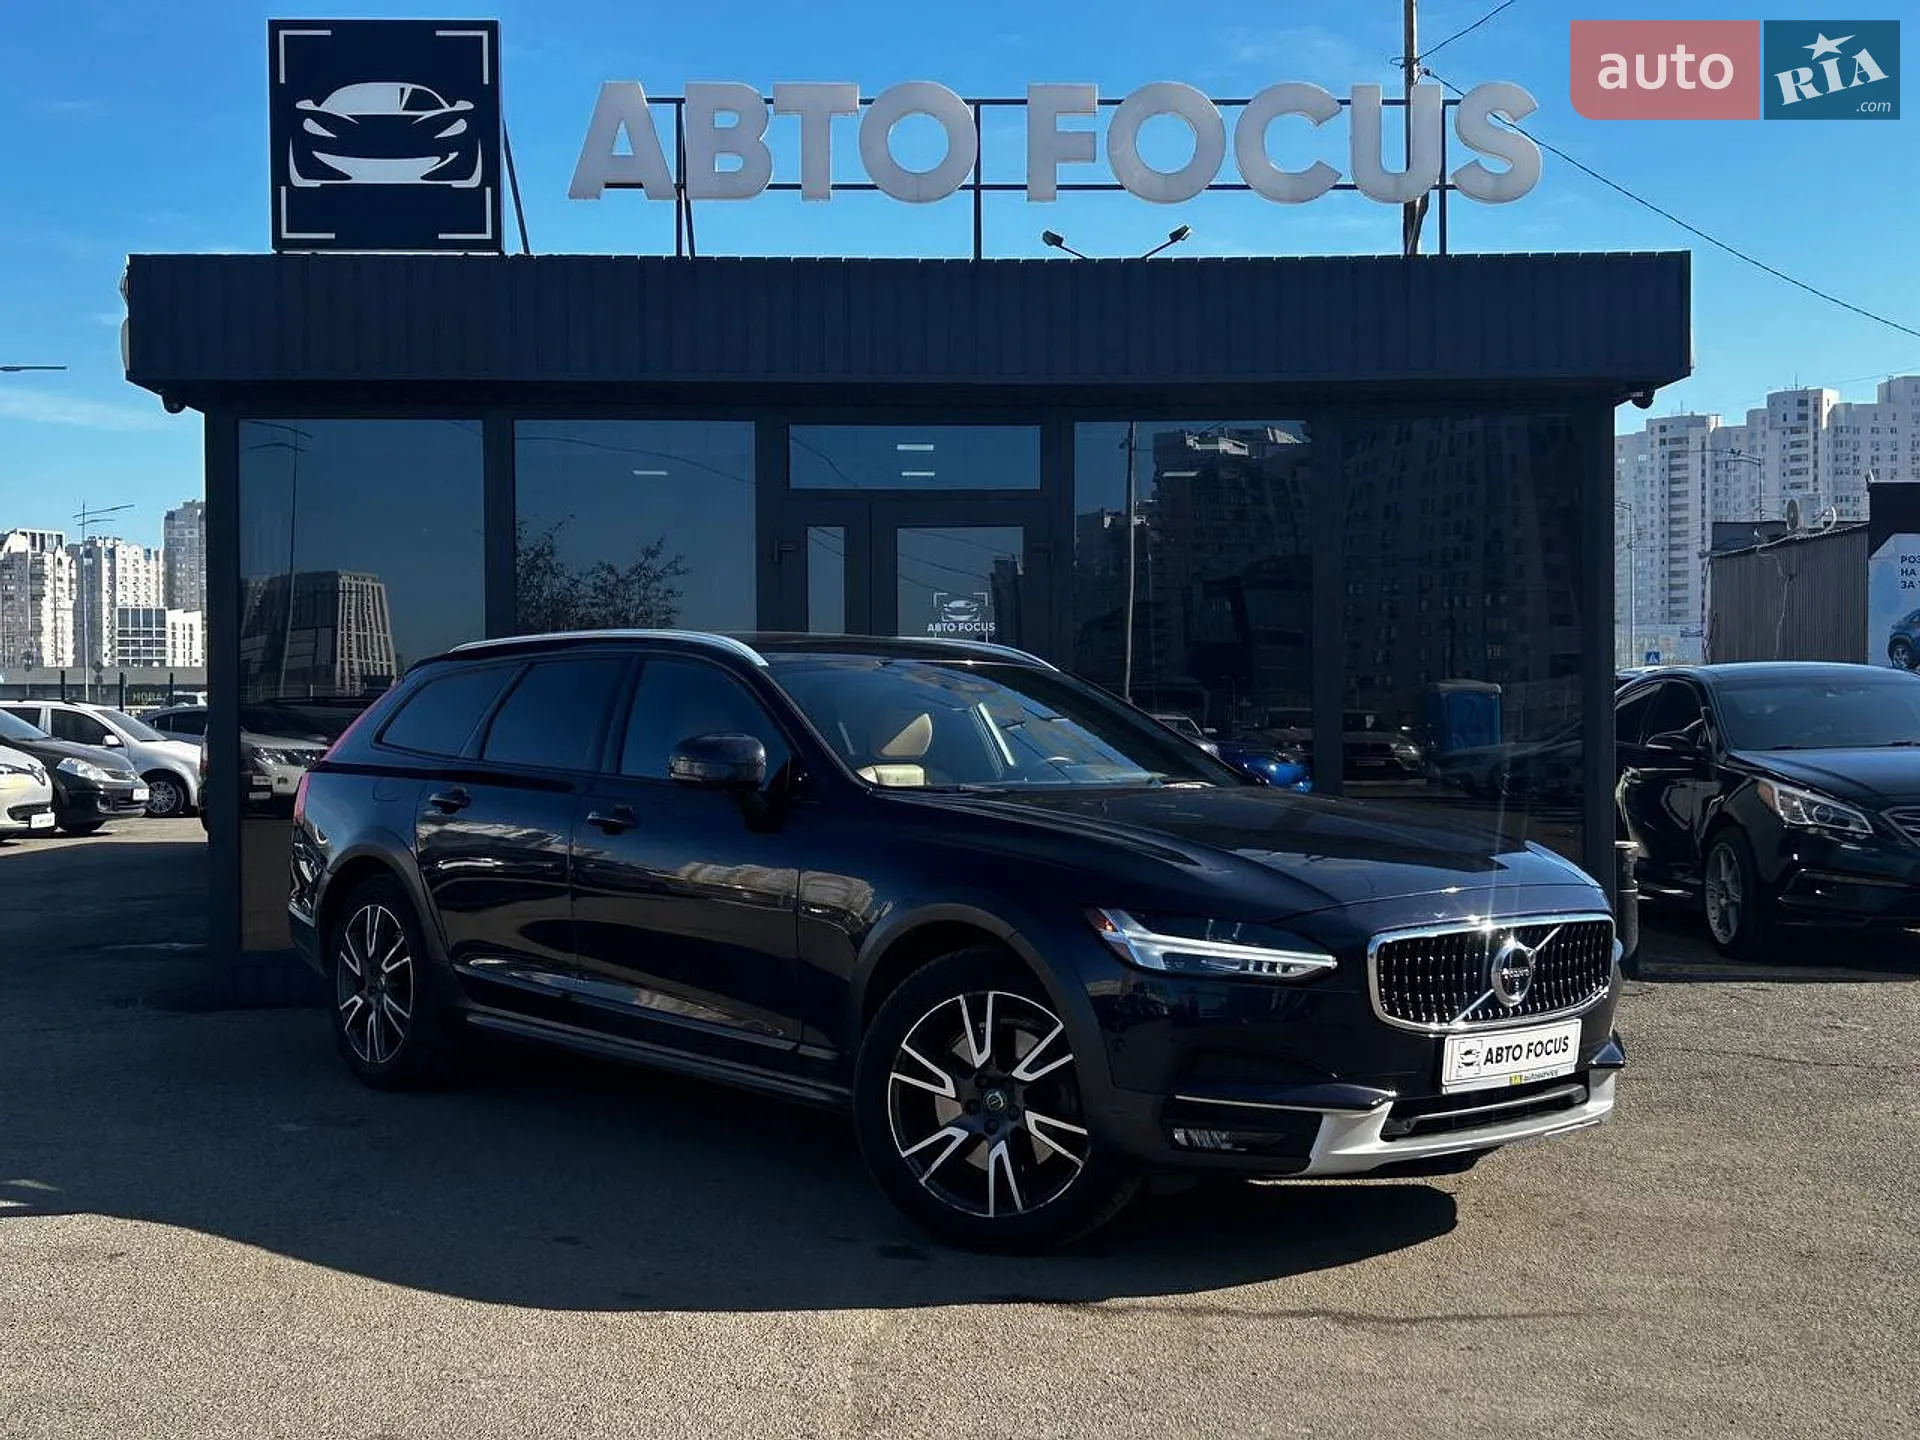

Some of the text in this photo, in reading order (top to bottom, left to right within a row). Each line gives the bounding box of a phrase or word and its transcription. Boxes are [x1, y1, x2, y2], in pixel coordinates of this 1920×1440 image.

[568, 80, 1542, 204] АВТО FOCUS
[1900, 568, 1917, 576] НА
[927, 621, 996, 633] АВТО FOCUS
[1483, 1036, 1569, 1066] АВТО FOCUS
